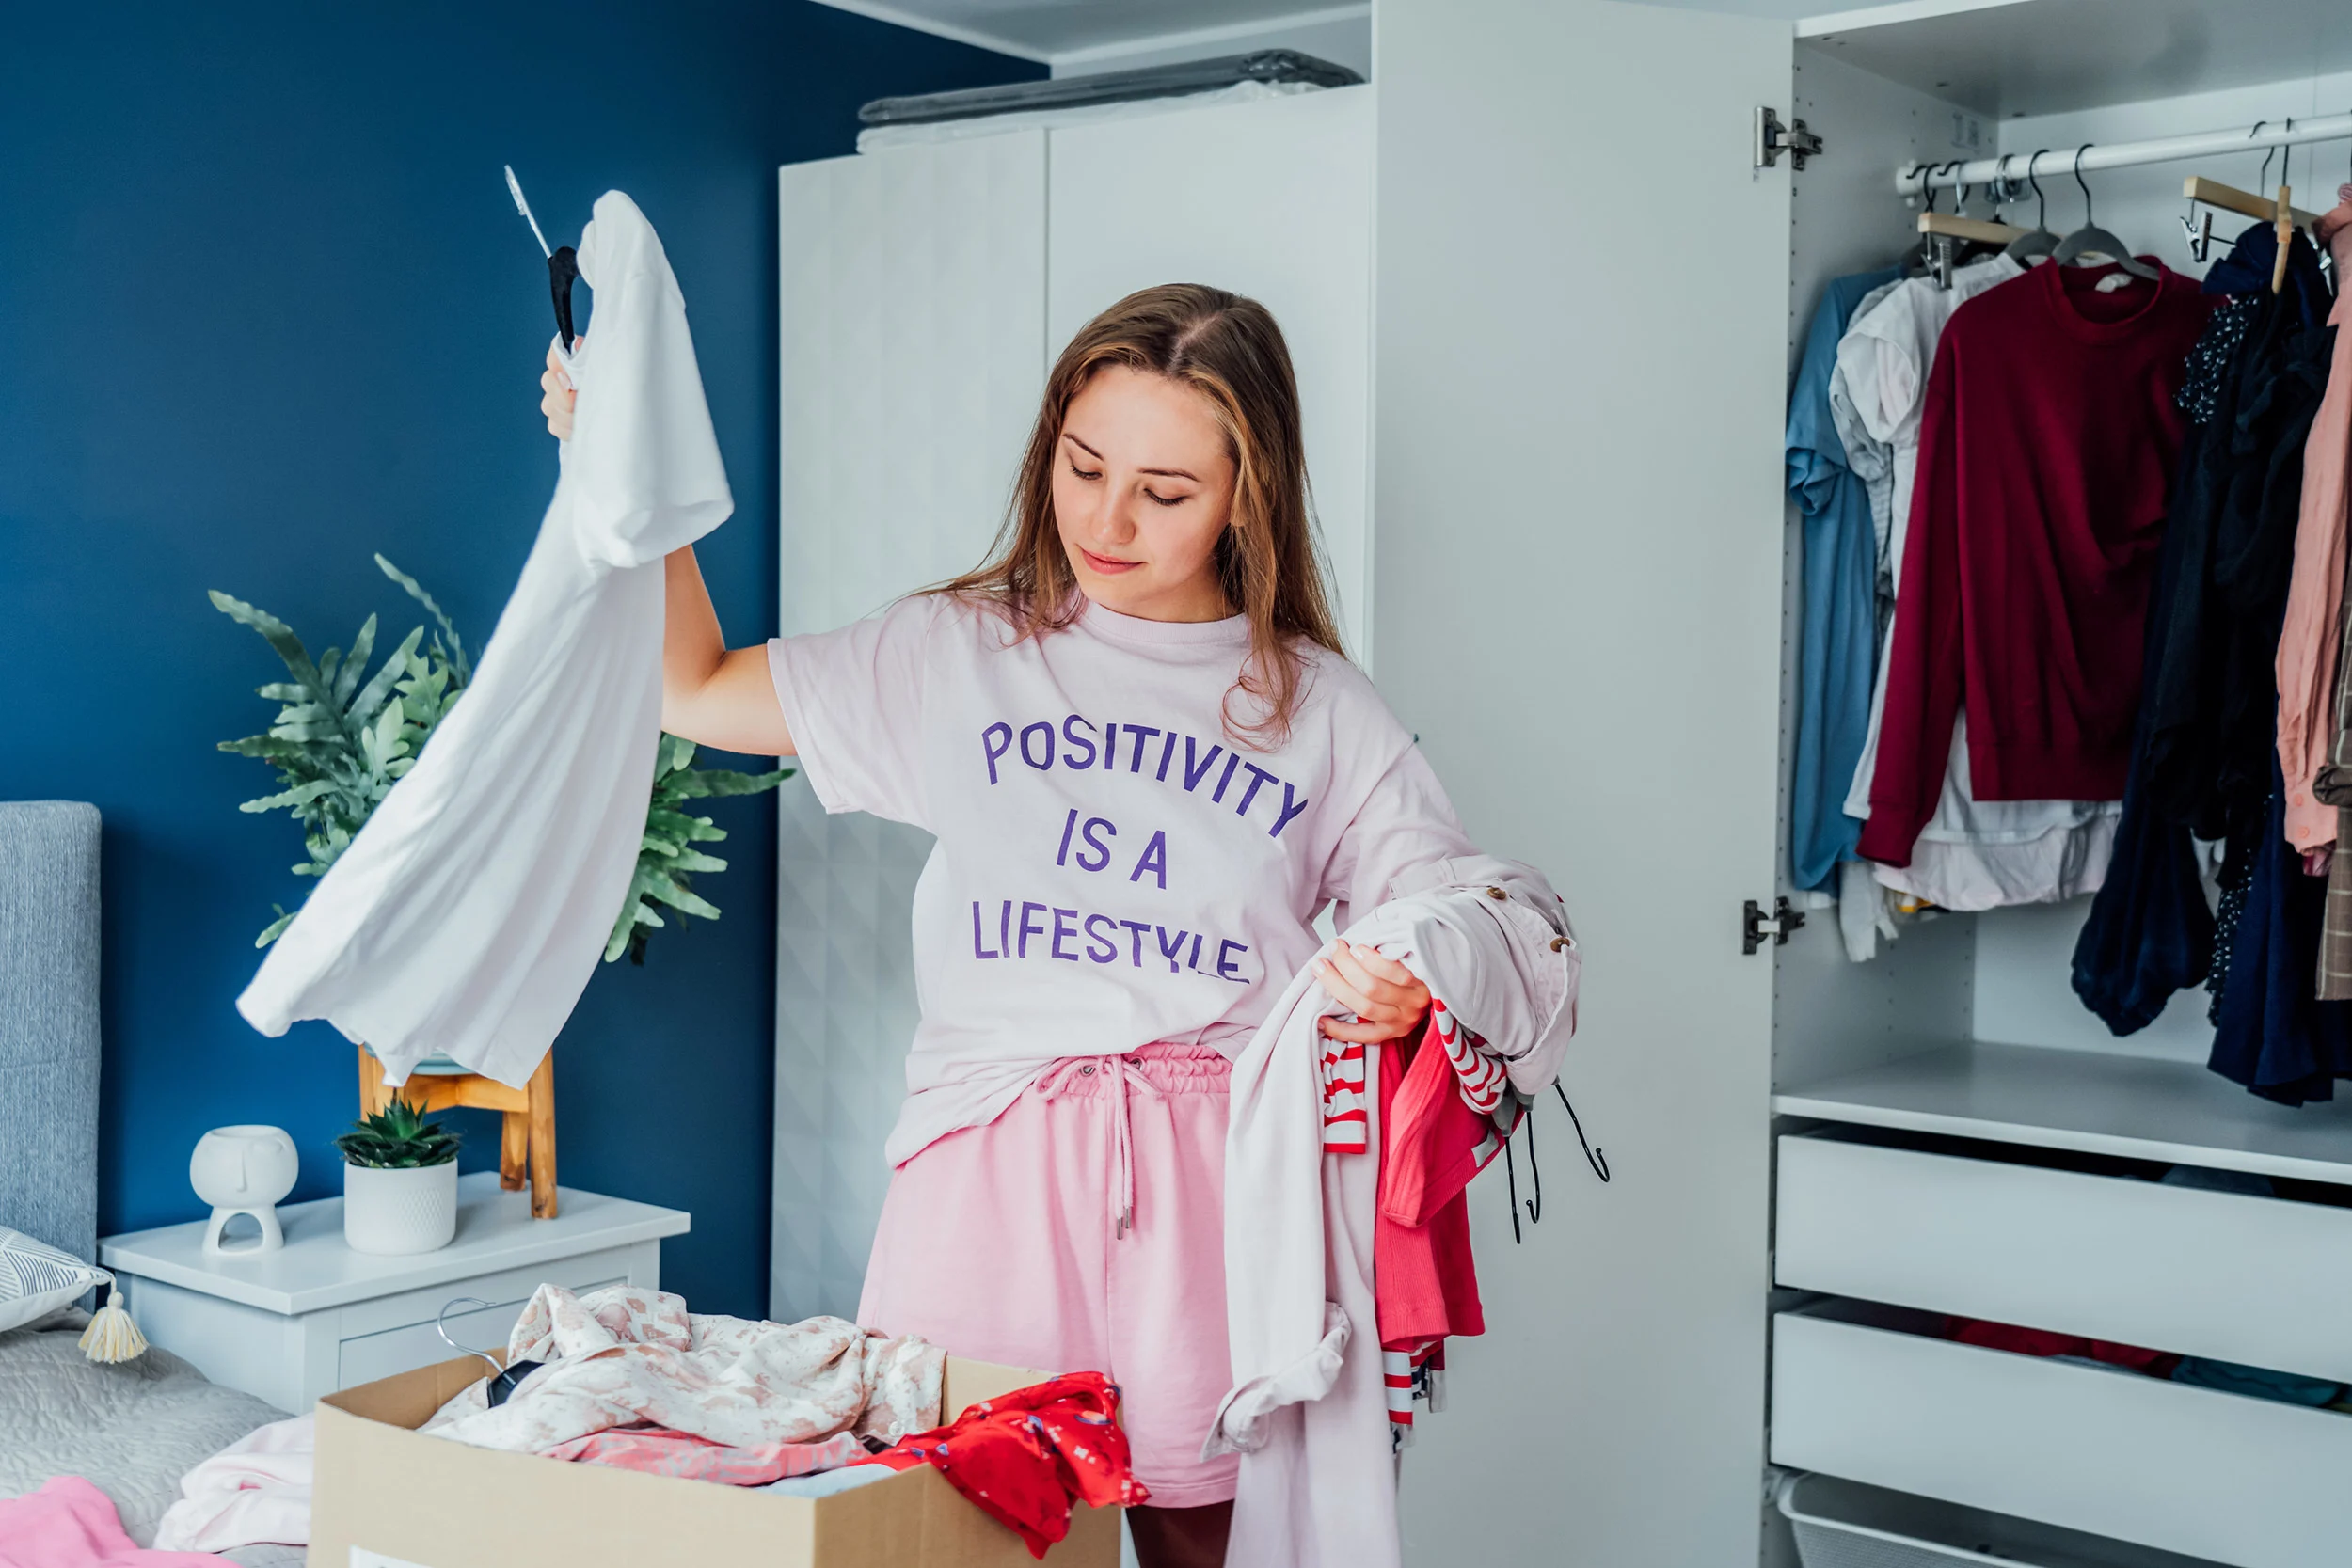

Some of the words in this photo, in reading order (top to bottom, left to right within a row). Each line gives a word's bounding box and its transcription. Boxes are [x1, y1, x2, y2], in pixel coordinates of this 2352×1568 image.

[981, 714, 1308, 838] POSITIVITY
[1057, 808, 1117, 872] IS
[1129, 830, 1167, 890] A
[972, 900, 1250, 984] LIFESTYLE
